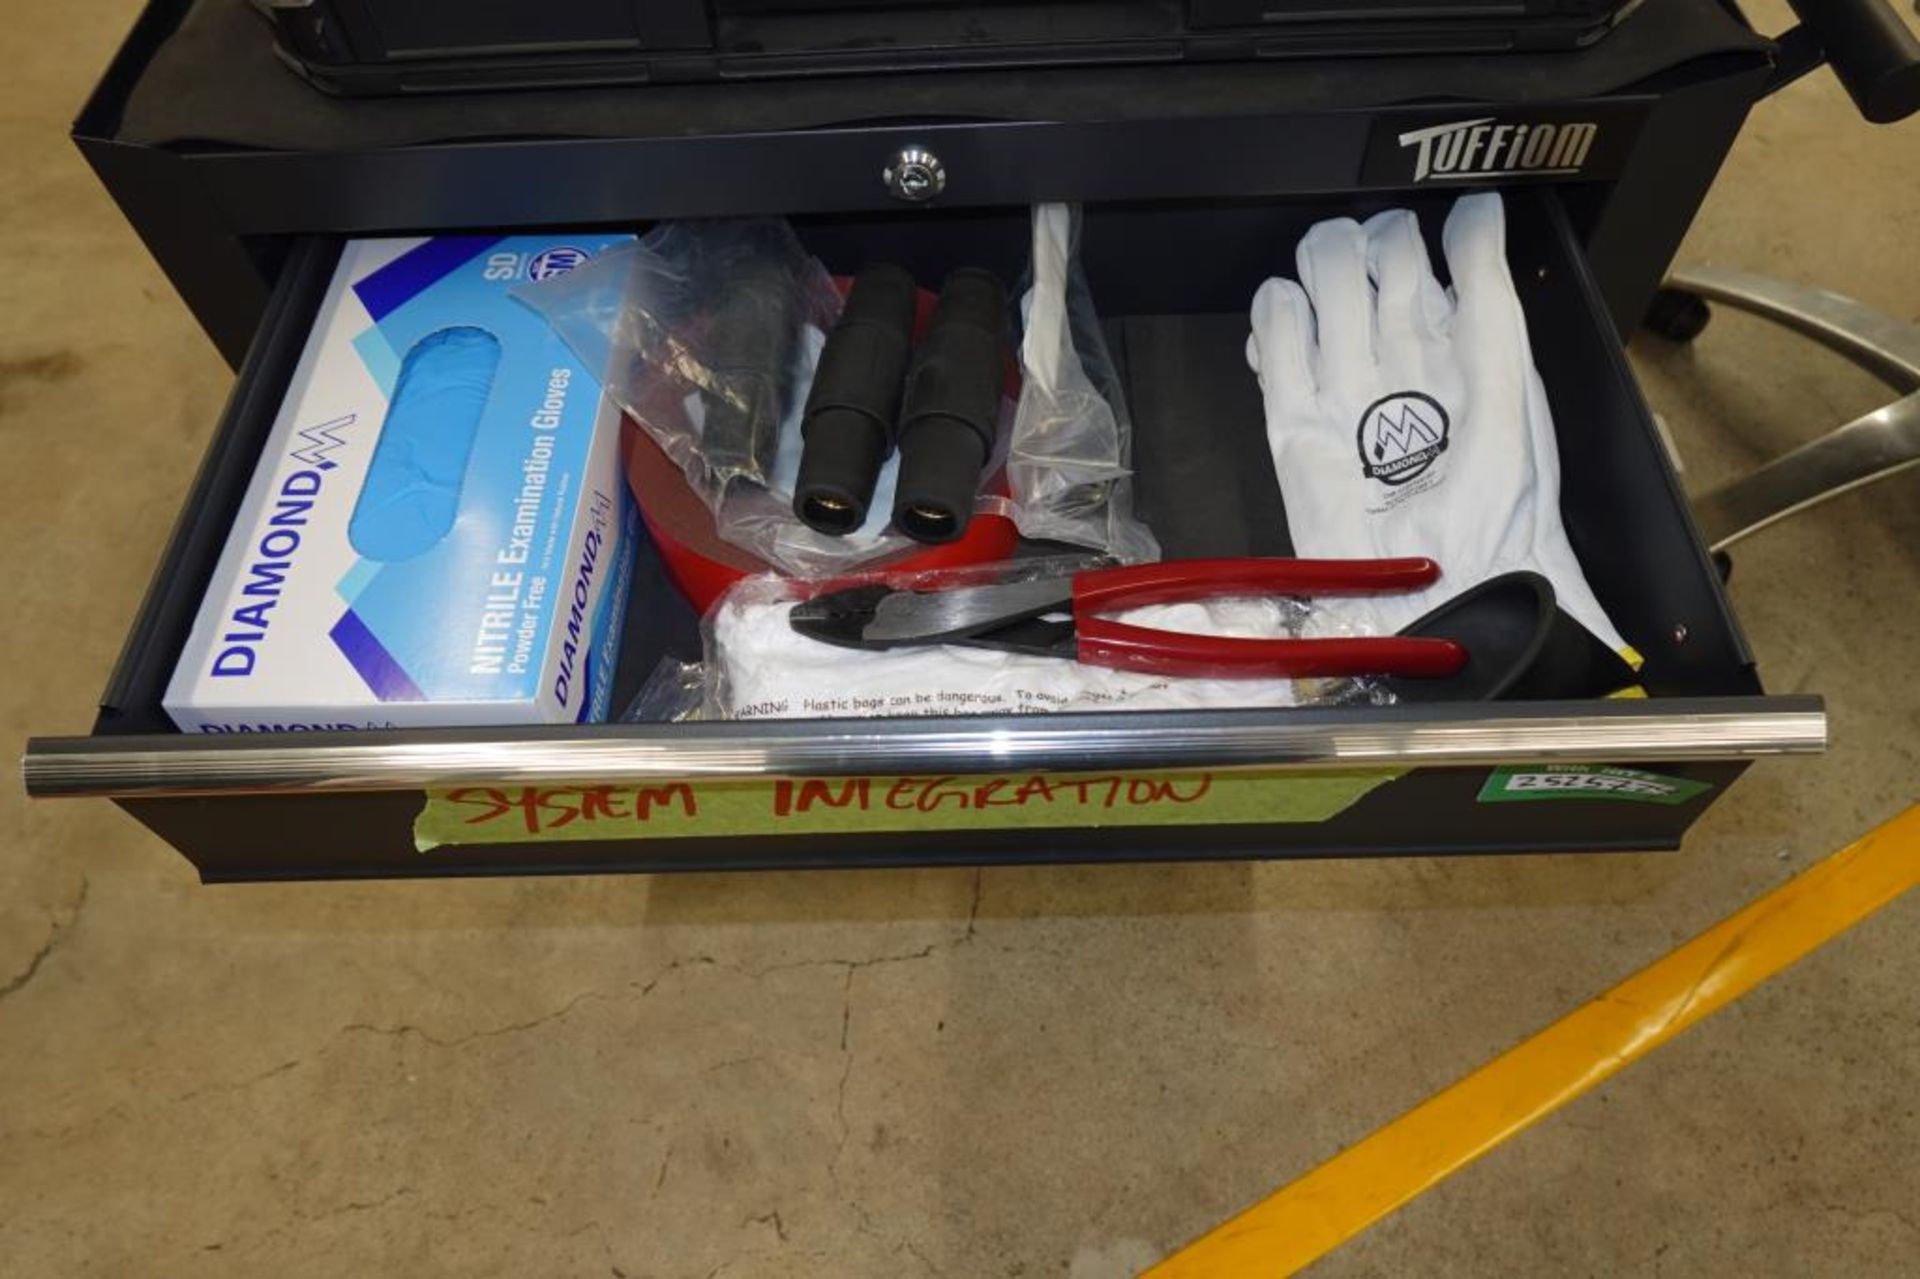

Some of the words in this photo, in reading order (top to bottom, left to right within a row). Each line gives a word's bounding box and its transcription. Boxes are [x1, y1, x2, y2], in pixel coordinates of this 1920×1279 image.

[483, 253, 518, 280] SD
[470, 570, 523, 675] NITRILE
[499, 435, 556, 565] Examination
[531, 368, 572, 430] Gloves
[211, 470, 322, 677] DIAMOND
[523, 575, 547, 612] Free
[508, 611, 540, 675] Powder
[555, 530, 599, 708] DIAMOND
[803, 698, 848, 712] Plastic
[853, 697, 884, 711] bags
[890, 696, 911, 706] can
[915, 693, 931, 704] be
[1016, 689, 1033, 700] To
[447, 782, 697, 833] SYSTEM
[774, 773, 1211, 816] INTEGRATION
